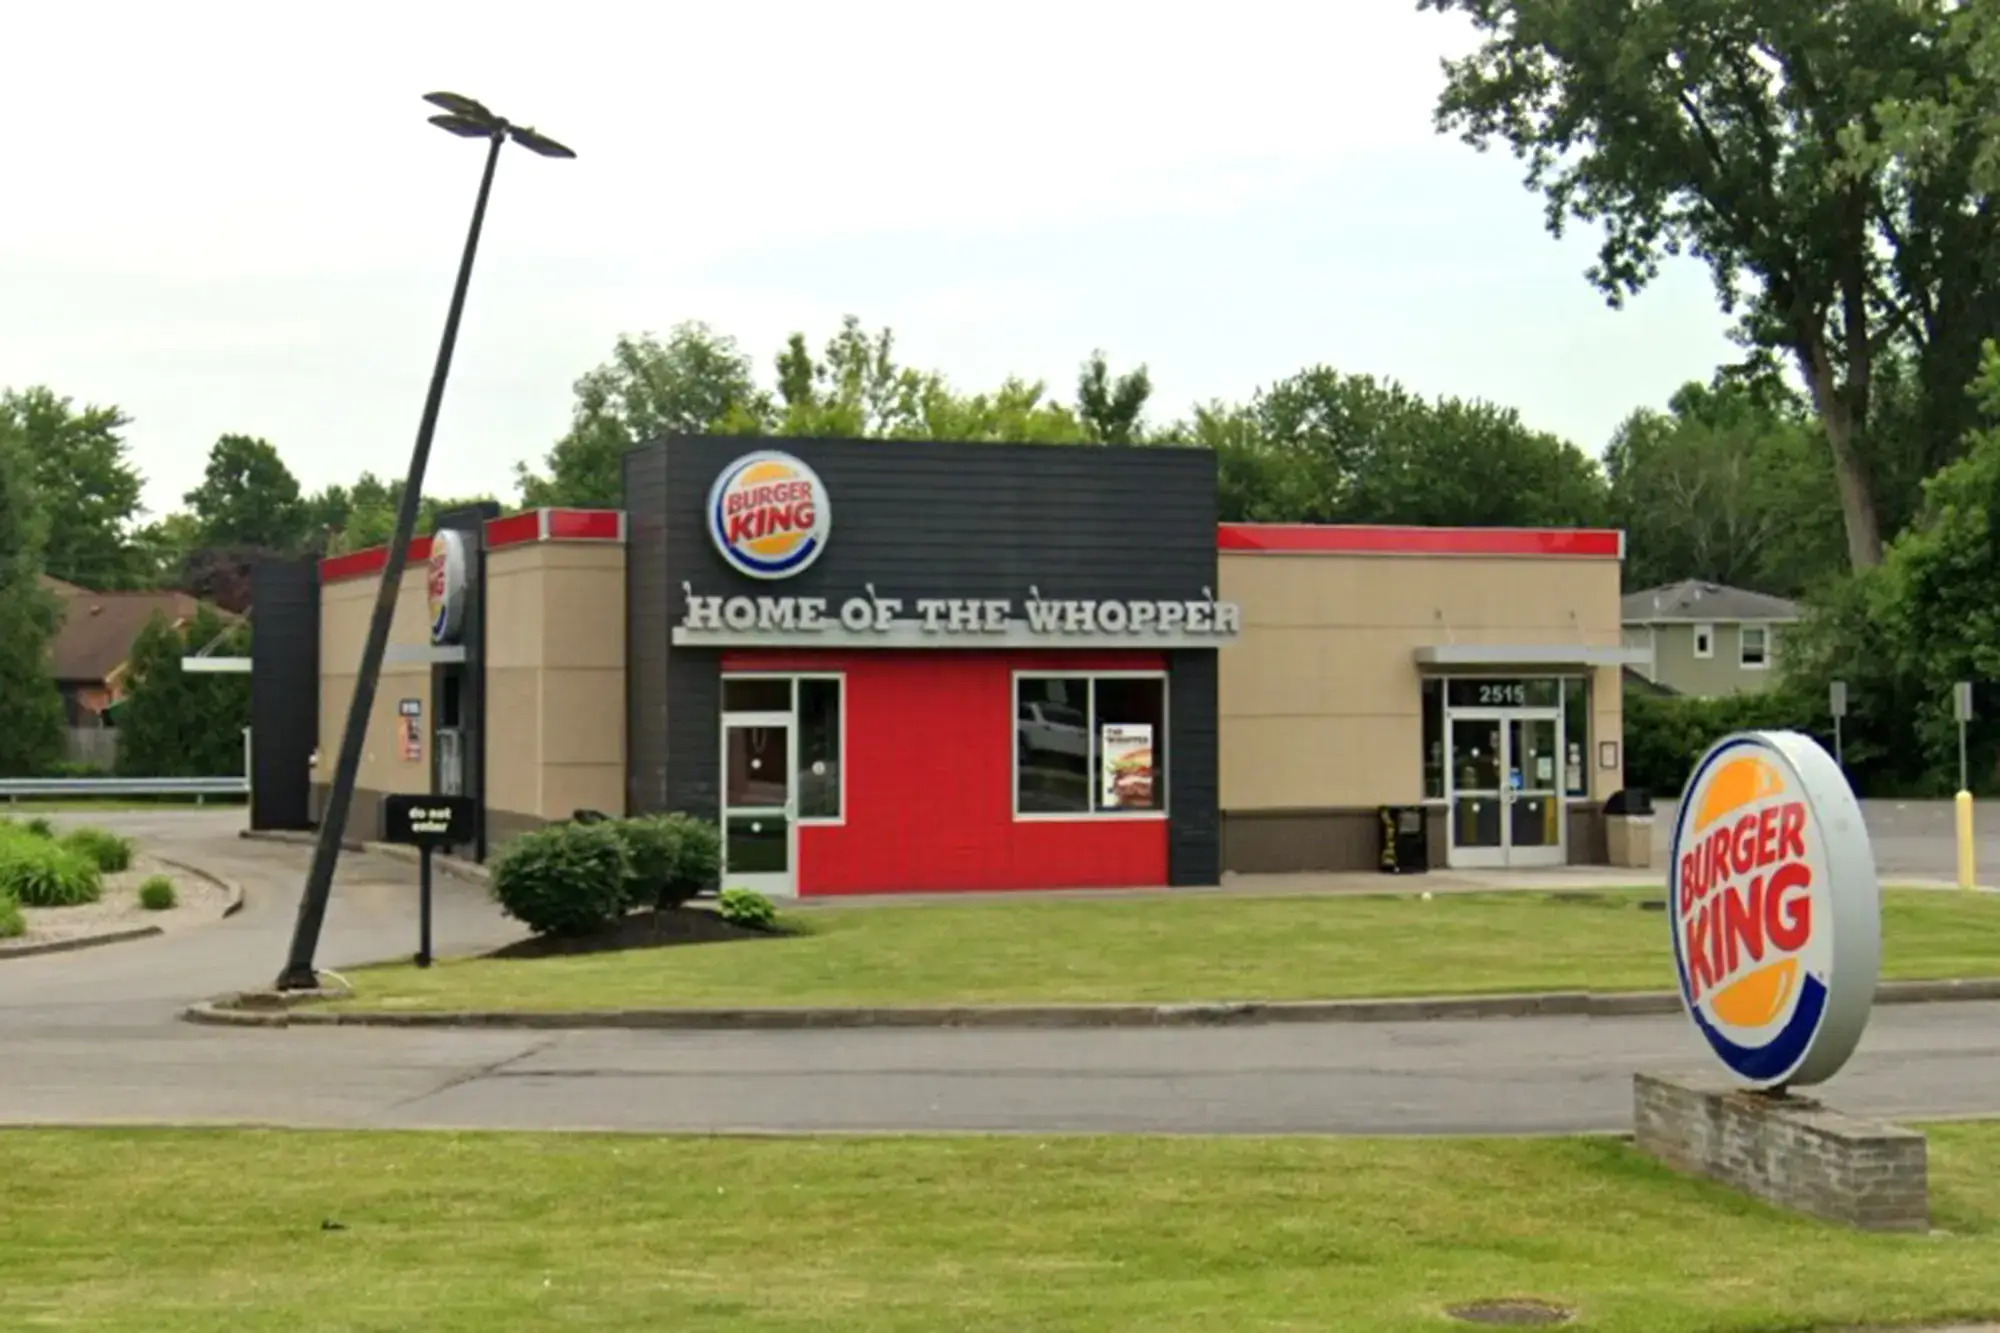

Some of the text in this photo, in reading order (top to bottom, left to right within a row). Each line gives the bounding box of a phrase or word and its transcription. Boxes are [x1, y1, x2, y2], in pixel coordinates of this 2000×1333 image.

[727, 481, 812, 516] BURGER
[729, 502, 815, 544] KING
[683, 596, 1241, 635] HOME OF THE WHOPPER
[1479, 685, 1524, 703] 2515
[408, 806, 452, 820] do not
[411, 821, 448, 833] enter
[1680, 802, 1806, 920] BURGER
[1685, 863, 1812, 1008] KING
